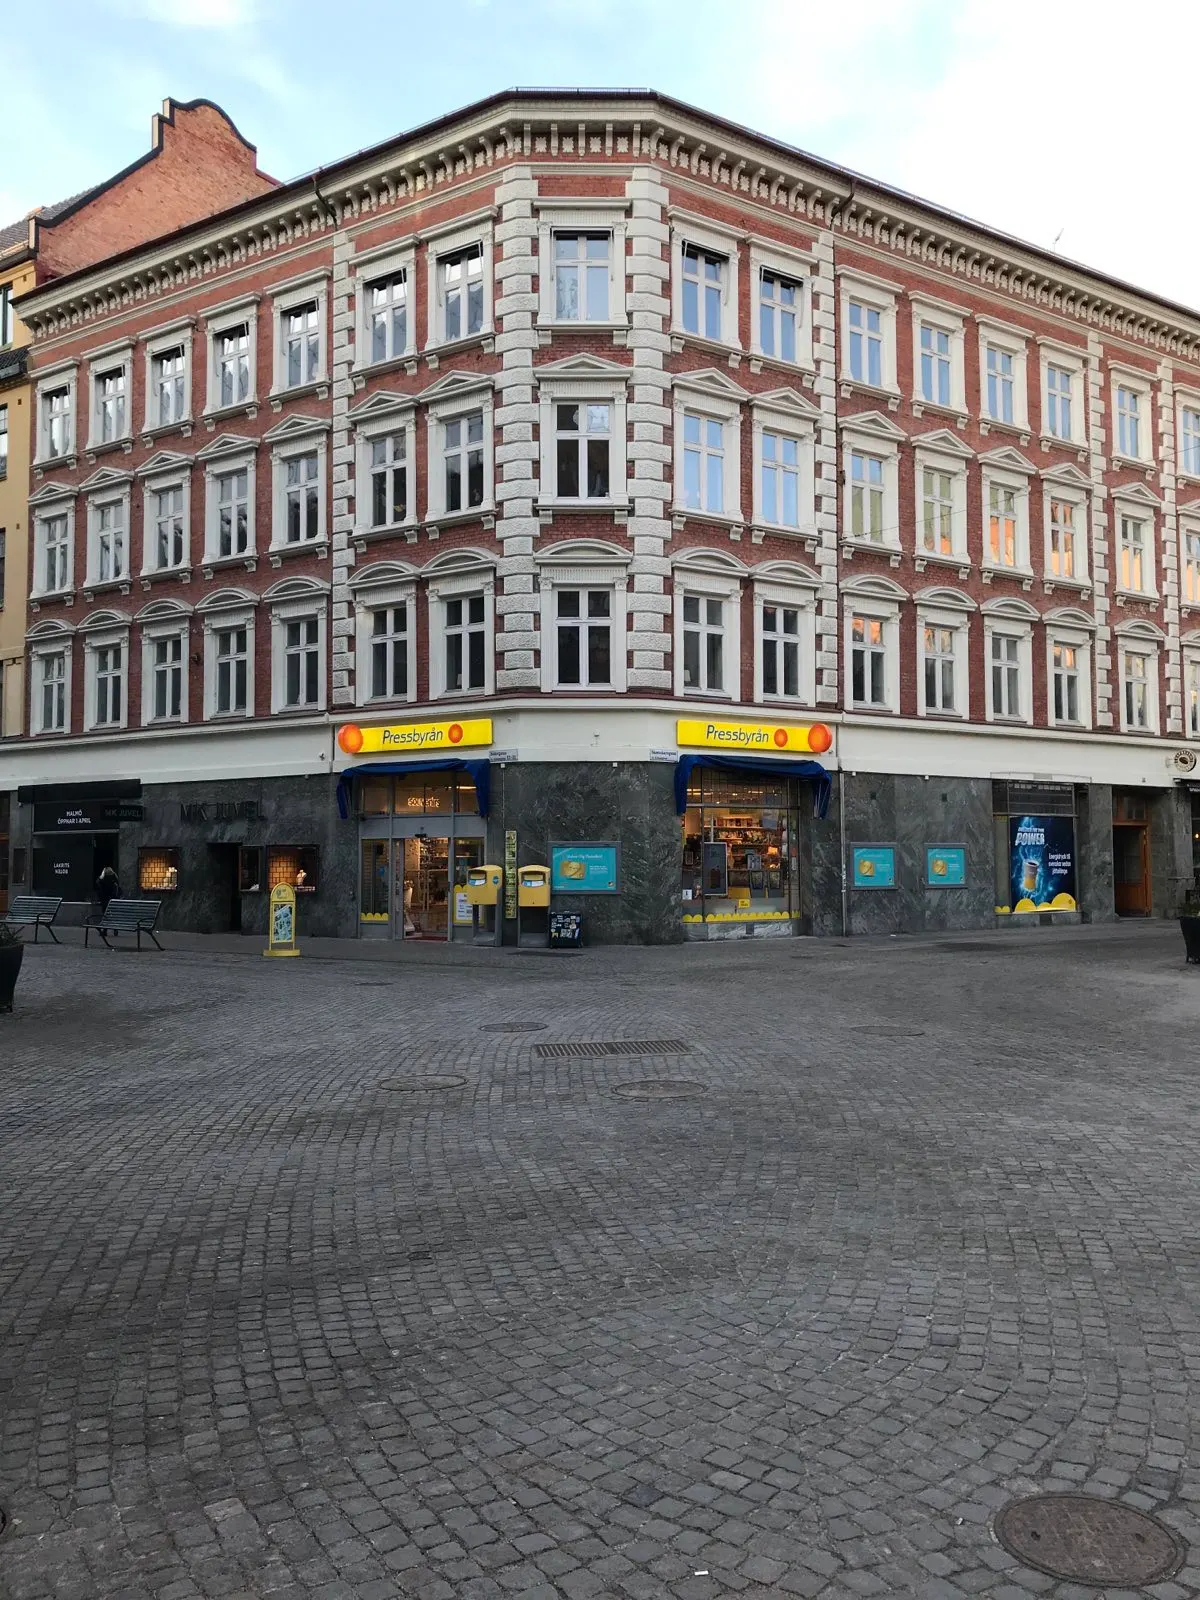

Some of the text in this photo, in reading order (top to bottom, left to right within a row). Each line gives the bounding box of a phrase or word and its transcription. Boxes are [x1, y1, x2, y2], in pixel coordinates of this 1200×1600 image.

[383, 727, 443, 745] Pressbyrån
[706, 724, 769, 745] Pressbyrån
[1015, 832, 1045, 846] POWER
